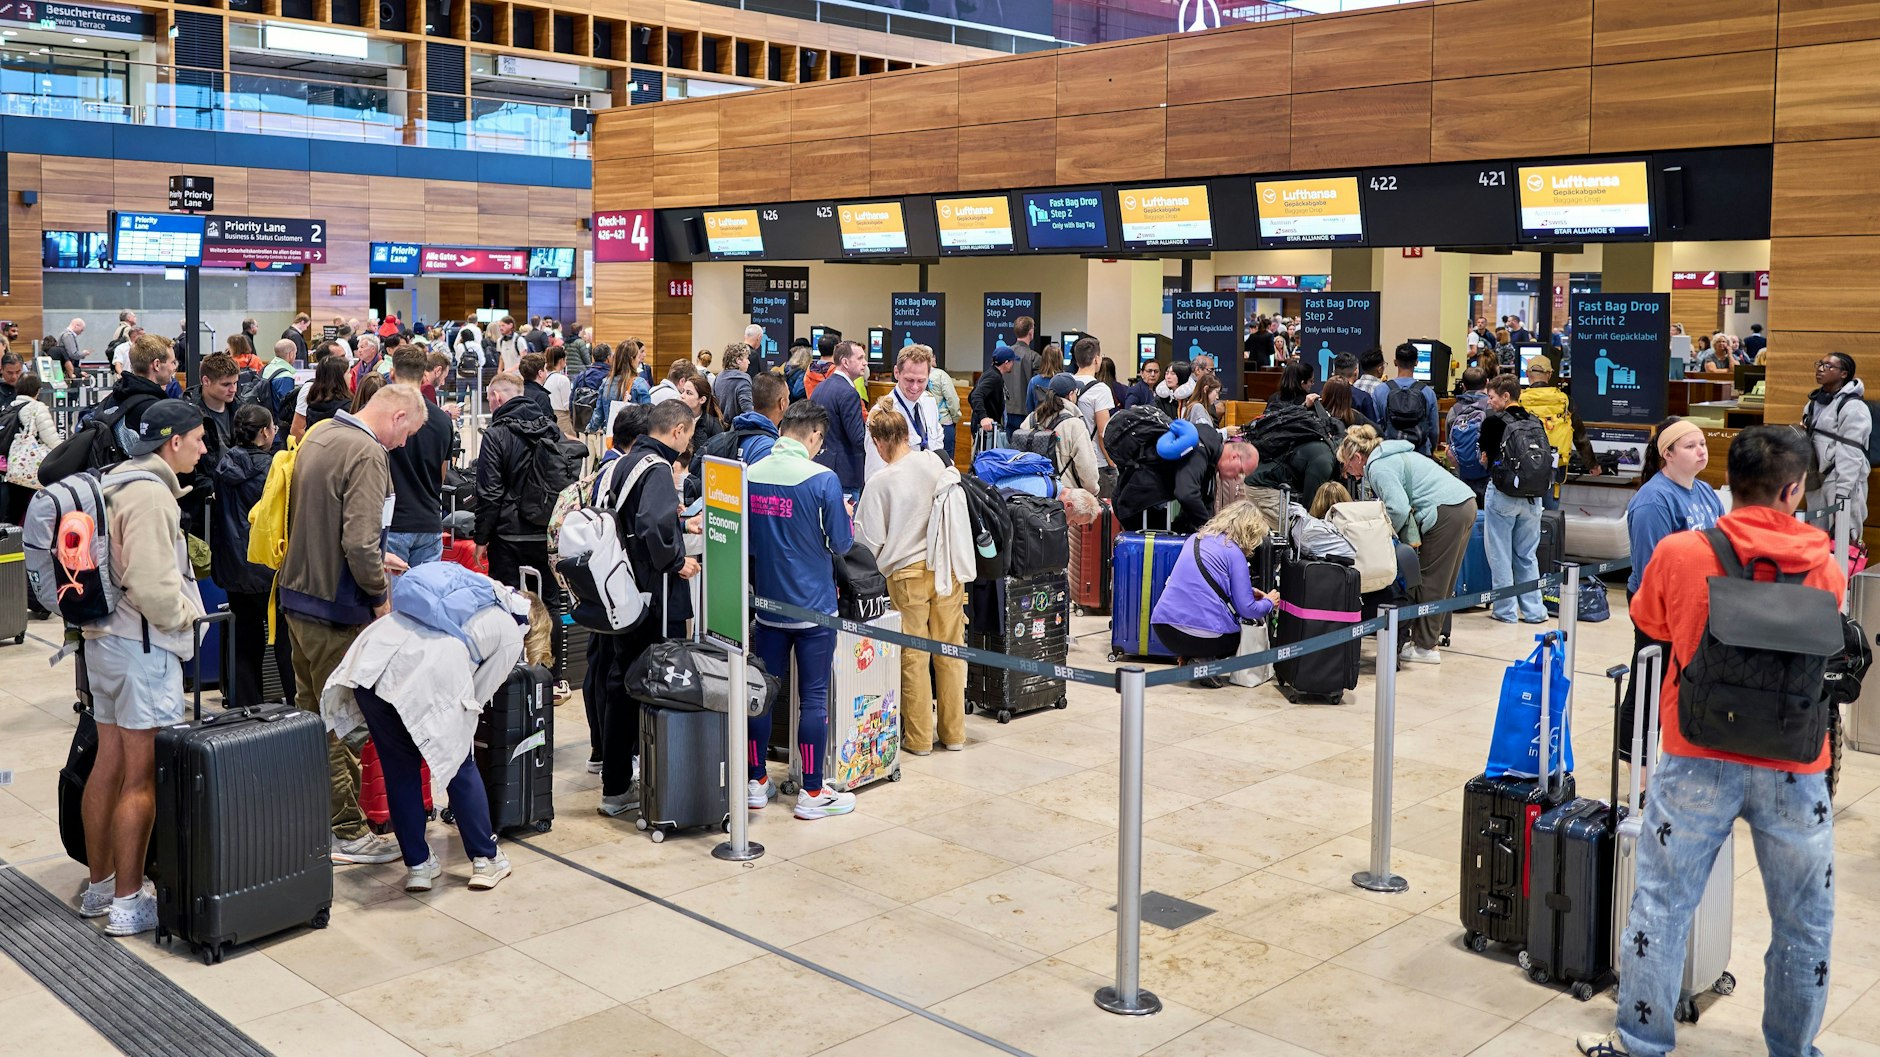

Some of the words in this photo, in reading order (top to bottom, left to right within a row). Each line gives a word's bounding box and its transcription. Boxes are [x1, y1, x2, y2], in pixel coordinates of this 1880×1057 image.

[46, 5, 131, 24] Besucherterrasse
[80, 20, 106, 30] Terrace
[1370, 176, 1398, 191] 422
[1478, 171, 1506, 187] 421
[1552, 175, 1620, 189] Lufthansa
[184, 191, 213, 202] Priority
[1282, 190, 1337, 201] Lufthansa
[1553, 188, 1607, 197] Gepäckabgabe
[184, 200, 202, 208] Lane
[1050, 198, 1065, 208] Fast
[1066, 199, 1079, 209] Bag
[1080, 198, 1098, 208] Drop
[1142, 197, 1190, 208] Lufthansa
[1284, 200, 1327, 208] Gepäckabgabe
[1554, 197, 1583, 205] Baggage
[1584, 196, 1601, 204] Drop
[763, 210, 779, 221] 426
[817, 207, 833, 218] 425
[855, 211, 889, 221] Lufthansa
[956, 206, 994, 217] Lufthansa
[1051, 210, 1066, 220] Step
[1067, 209, 1073, 218] 2
[135, 216, 158, 225] Priority
[719, 218, 748, 227] Lufthansa
[1086, 222, 1095, 230] Tag
[225, 221, 262, 233] Priority
[264, 223, 286, 233] Lane
[311, 225, 322, 243] 2
[225, 233, 250, 241] Business
[598, 215, 626, 227] Check-in
[631, 215, 649, 251] 4
[391, 246, 419, 257] Priority
[426, 252, 439, 261] Alle
[440, 253, 457, 261] Gates
[390, 255, 408, 264] Lane
[753, 297, 764, 305] Fast
[764, 298, 774, 306] Bag
[775, 298, 787, 306] Drop
[895, 298, 908, 306] Fast
[909, 298, 921, 308] Bag
[922, 299, 937, 309] Drop
[987, 299, 1001, 307] Fast
[1001, 299, 1014, 309] Bag
[1015, 299, 1032, 309] Drop
[1177, 299, 1195, 308] Fast
[1196, 299, 1212, 310] Bag
[1214, 299, 1235, 310] Drop
[1306, 299, 1325, 308] Fast
[1327, 299, 1345, 311] Bag
[1347, 299, 1370, 310] Drop
[753, 307, 764, 315] Step
[895, 308, 915, 316] Schritt
[1578, 301, 1602, 312] Fast
[1605, 302, 1627, 314] Bag
[1631, 301, 1660, 314] Drop
[987, 309, 1001, 318] Step
[1002, 309, 1007, 317] 2
[1177, 311, 1205, 320] Schritt
[1205, 311, 1211, 320] 2
[1305, 312, 1326, 322] Step
[1328, 312, 1334, 321] 2
[987, 321, 997, 329] Only
[1578, 315, 1616, 326] Schritt
[1619, 316, 1625, 326] 2
[1189, 324, 1199, 332] mit
[1200, 324, 1234, 334] Gepäcklabel
[1305, 326, 1320, 335] Only
[1321, 326, 1336, 334] with
[1337, 327, 1350, 335] Bag
[1351, 327, 1362, 336] Tag
[1595, 332, 1609, 341] mit
[1610, 333, 1658, 342] Gepäcklabel
[708, 487, 740, 506] Lufthansa
[780, 498, 793, 509] 20
[780, 508, 793, 518] 25
[709, 512, 740, 535] Economy
[709, 527, 727, 544] Class
[1538, 578, 1547, 589] BER
[1481, 592, 1491, 603] BER
[755, 597, 769, 610] BER
[1418, 605, 1429, 616] BER
[842, 621, 858, 633] BER
[1352, 625, 1364, 638] BER
[941, 644, 959, 657] BER
[1278, 647, 1291, 660] BER
[1054, 665, 1074, 680] BER
[1194, 665, 1209, 678] BER
